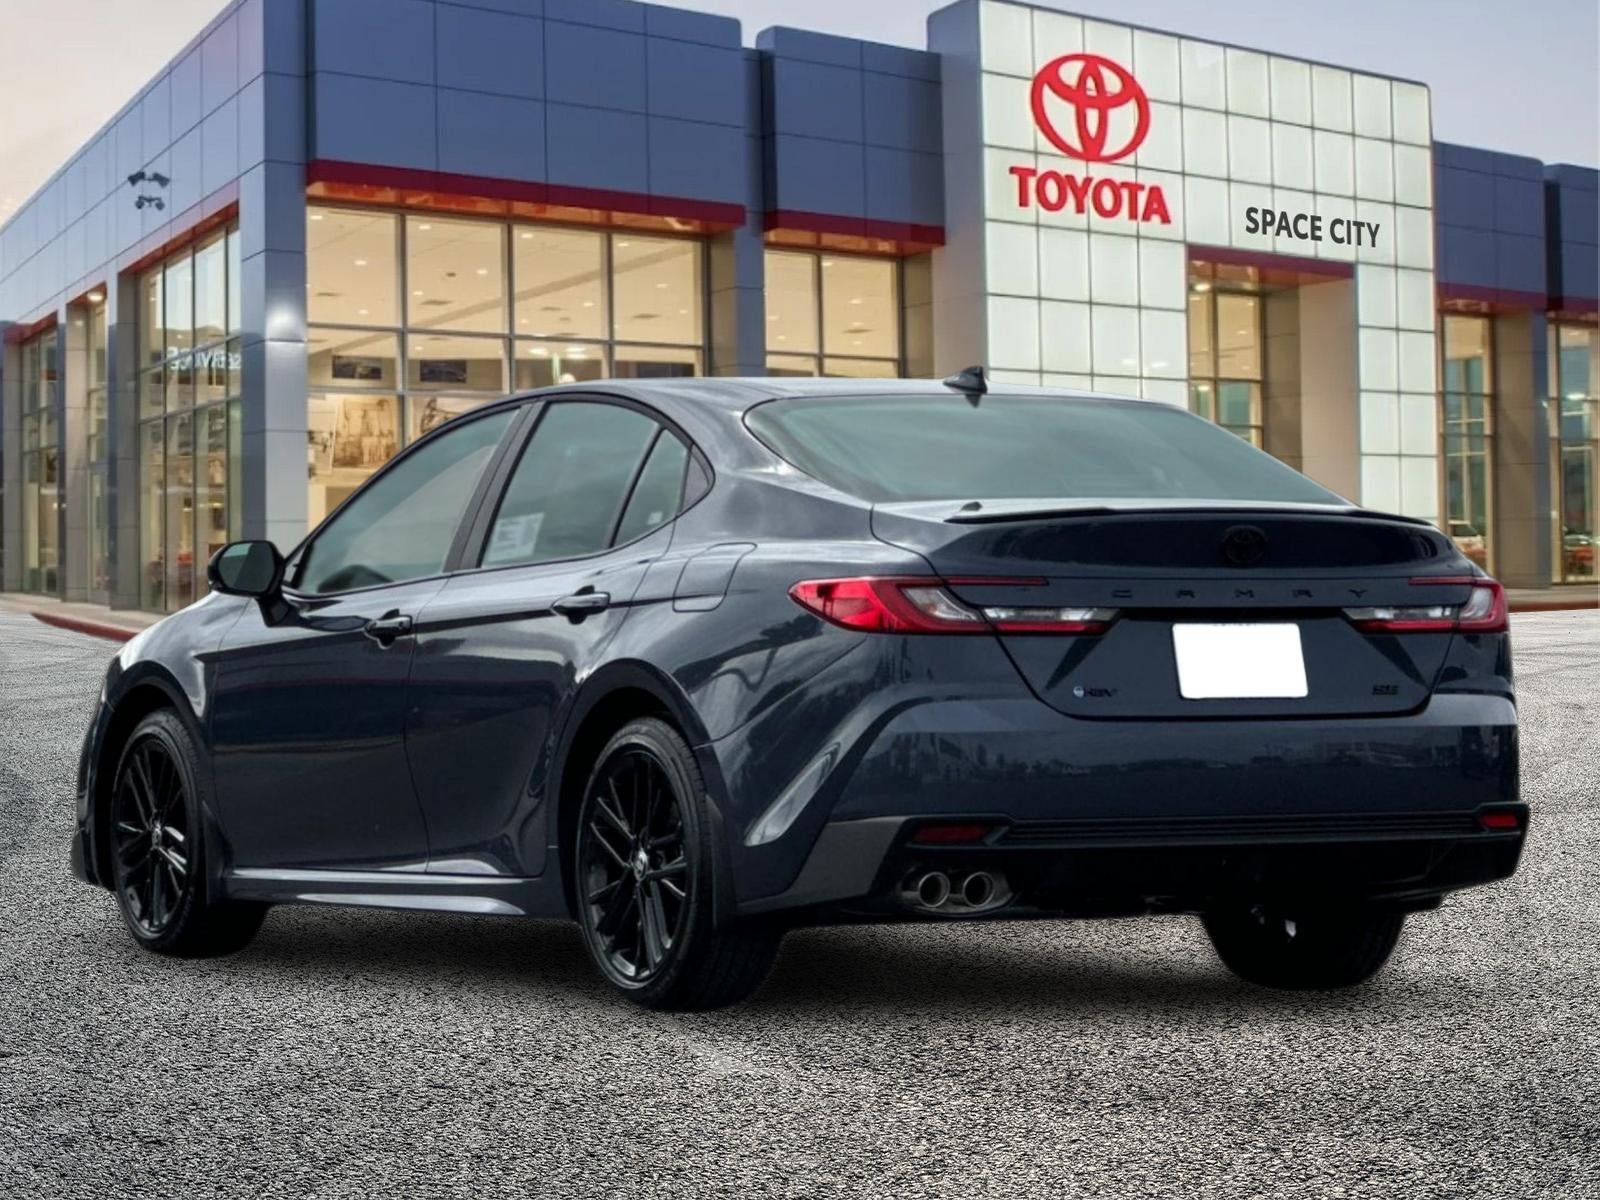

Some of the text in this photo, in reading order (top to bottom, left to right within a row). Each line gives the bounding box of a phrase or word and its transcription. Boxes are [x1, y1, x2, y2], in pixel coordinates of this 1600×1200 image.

[1010, 167, 1171, 224] TOYOTA
[1246, 206, 1380, 248] SPACE CITY
[1111, 588, 1367, 599] CAMRY
